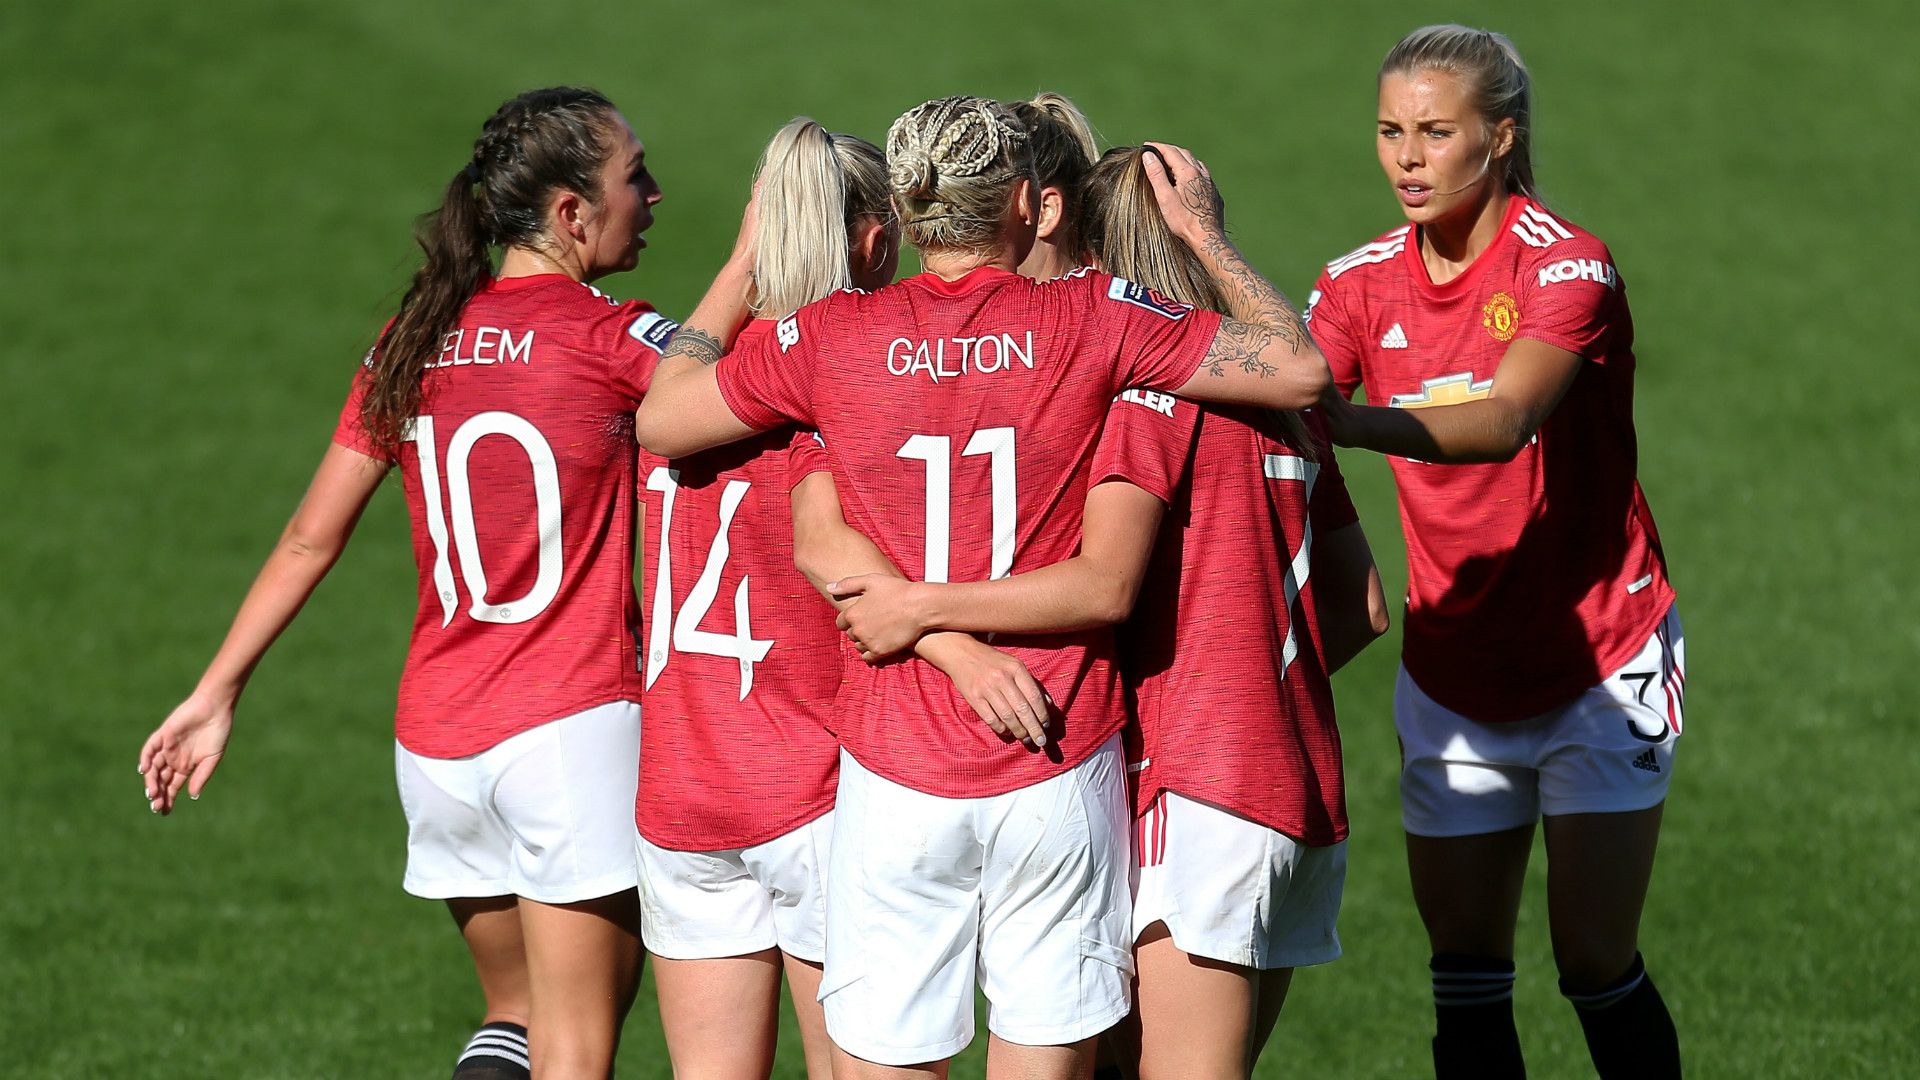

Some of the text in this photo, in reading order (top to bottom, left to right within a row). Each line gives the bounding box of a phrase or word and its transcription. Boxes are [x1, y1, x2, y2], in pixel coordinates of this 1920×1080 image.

[1538, 258, 1617, 291] KOHLE
[424, 326, 535, 369] ELEM
[886, 330, 1034, 385] GALTON
[1381, 339, 1409, 349] adidas
[400, 411, 563, 630] 10
[895, 426, 1017, 584] 11
[646, 467, 775, 702] 14
[1265, 455, 1320, 681] 7
[1619, 672, 1670, 743] 3
[1632, 760, 1661, 773] adidas
